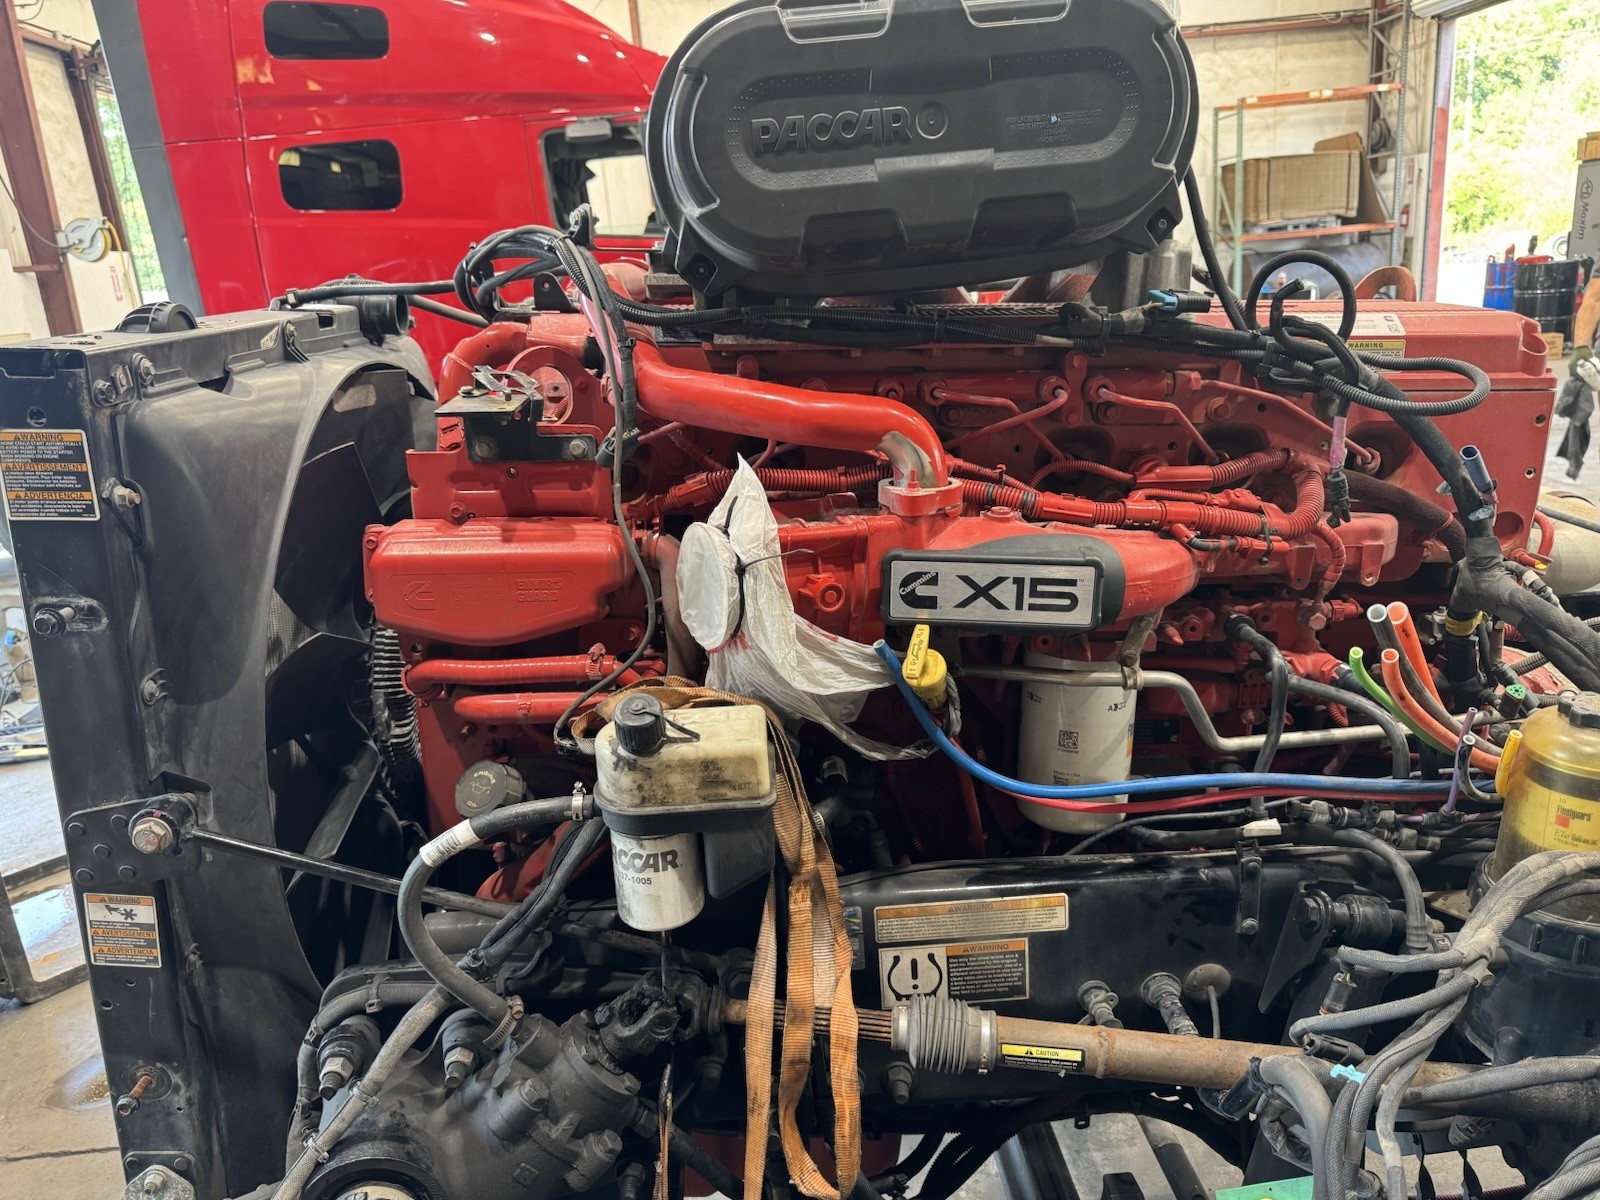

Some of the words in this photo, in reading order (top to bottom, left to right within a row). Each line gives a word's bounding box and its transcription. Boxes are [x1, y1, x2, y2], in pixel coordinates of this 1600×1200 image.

[751, 105, 912, 152] PACCAR
[1577, 201, 1589, 240] Maxim
[21, 433, 64, 441] WARNING
[12, 463, 84, 471] AVERTISSEMENT
[899, 571, 937, 595] Cummins
[953, 575, 1079, 612] X15
[474, 770, 496, 784] ENGINE
[1557, 804, 1592, 822] Fleetguard
[108, 896, 141, 904] WARNING
[951, 903, 994, 912] WARNING
[102, 930, 155, 938] AVERTISSEMENT
[107, 948, 154, 956] ADVERTENCIA
[970, 944, 1010, 952] WARNING
